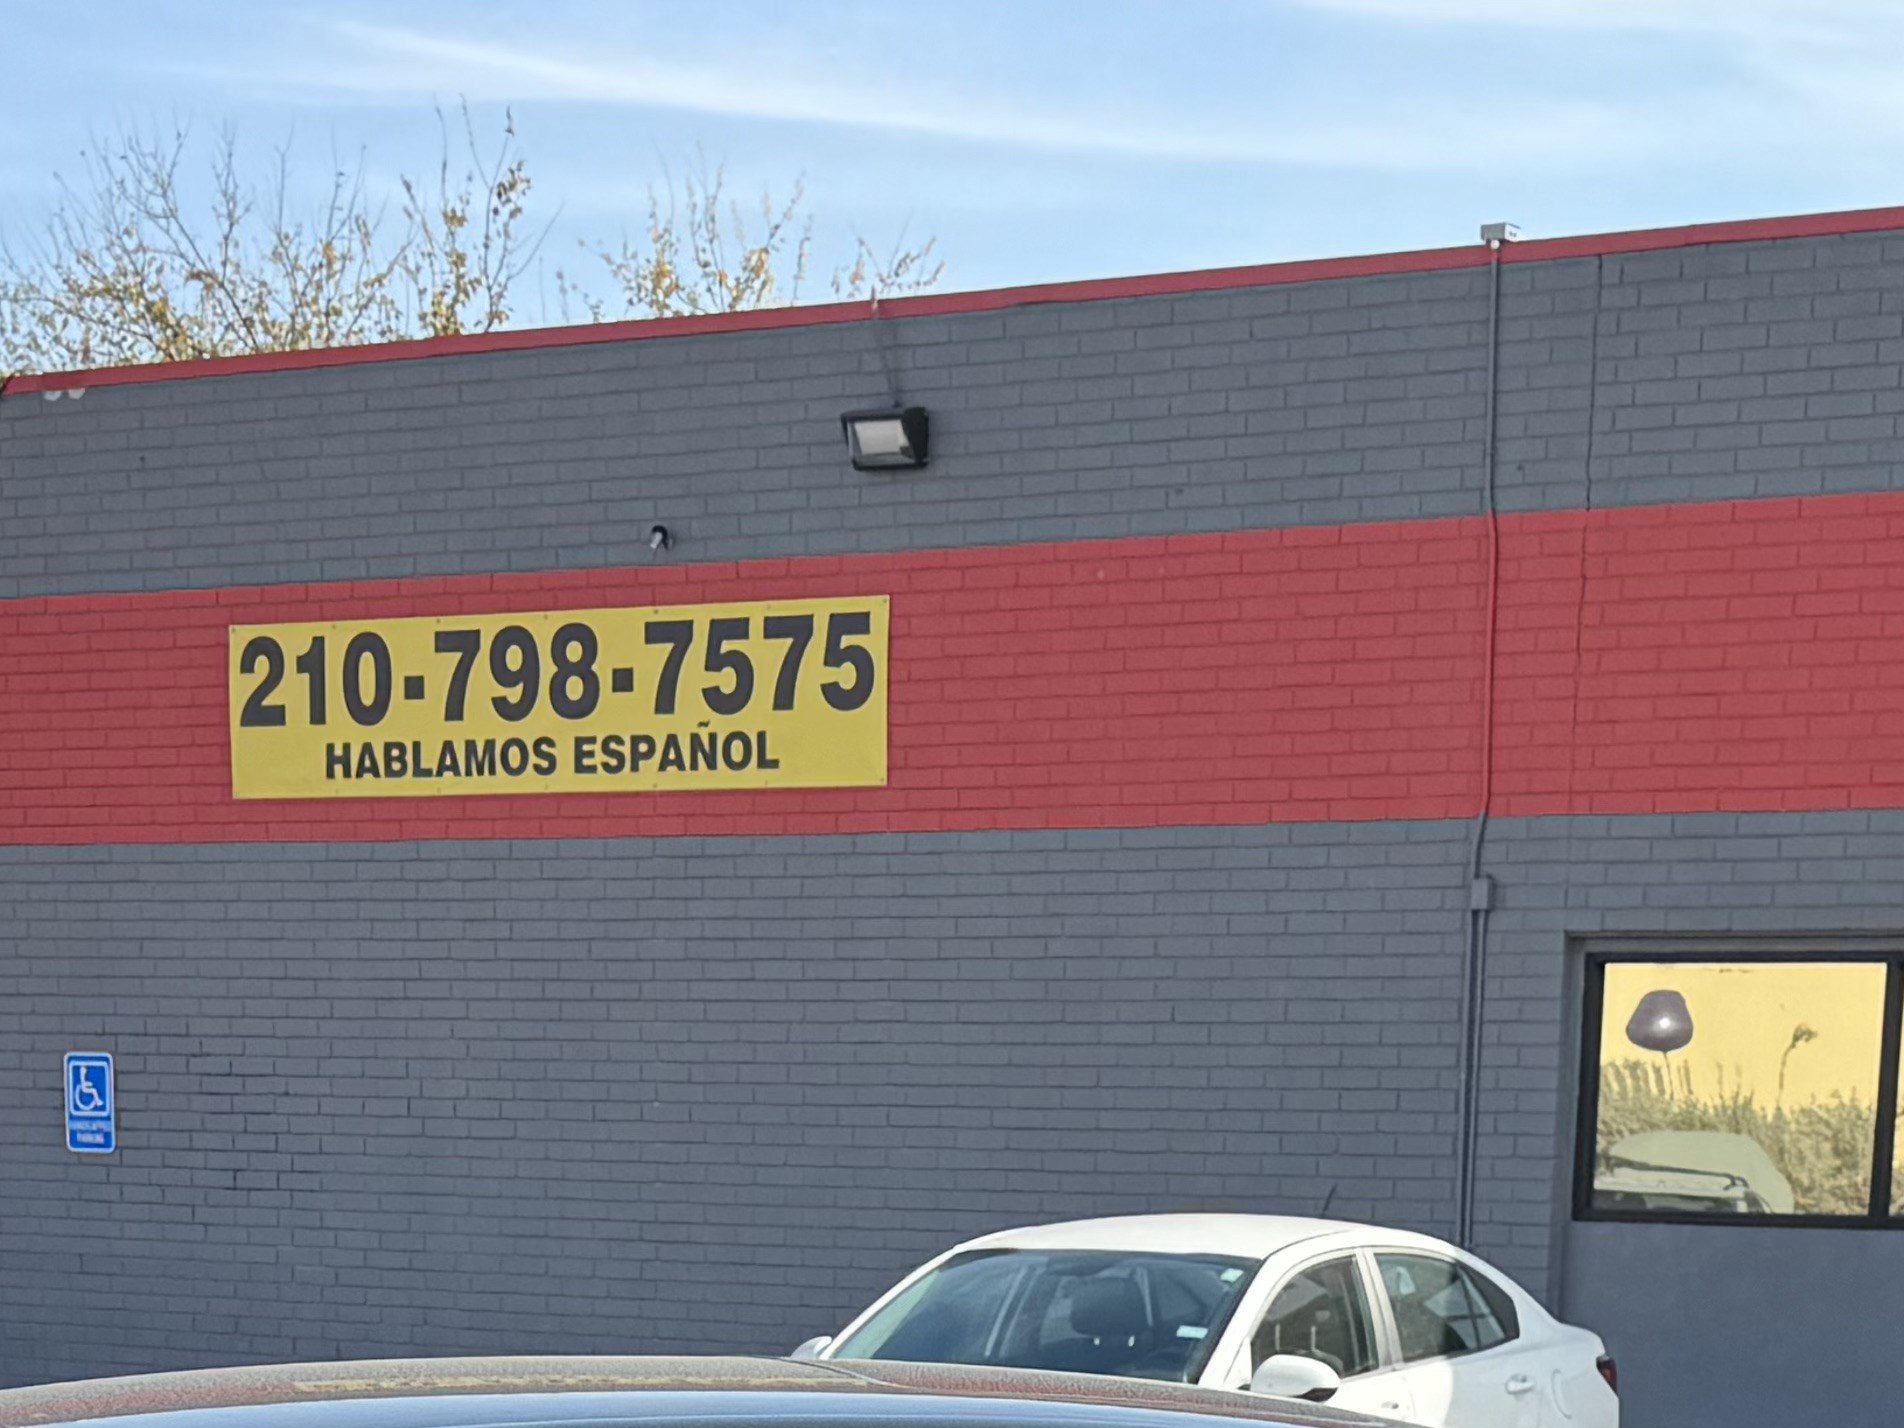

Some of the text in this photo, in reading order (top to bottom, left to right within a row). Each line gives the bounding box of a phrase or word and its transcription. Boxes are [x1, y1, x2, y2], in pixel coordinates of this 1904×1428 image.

[238, 610, 876, 729] 210-798-7575
[325, 720, 781, 780] HABLAMOS ESPAÑOL
